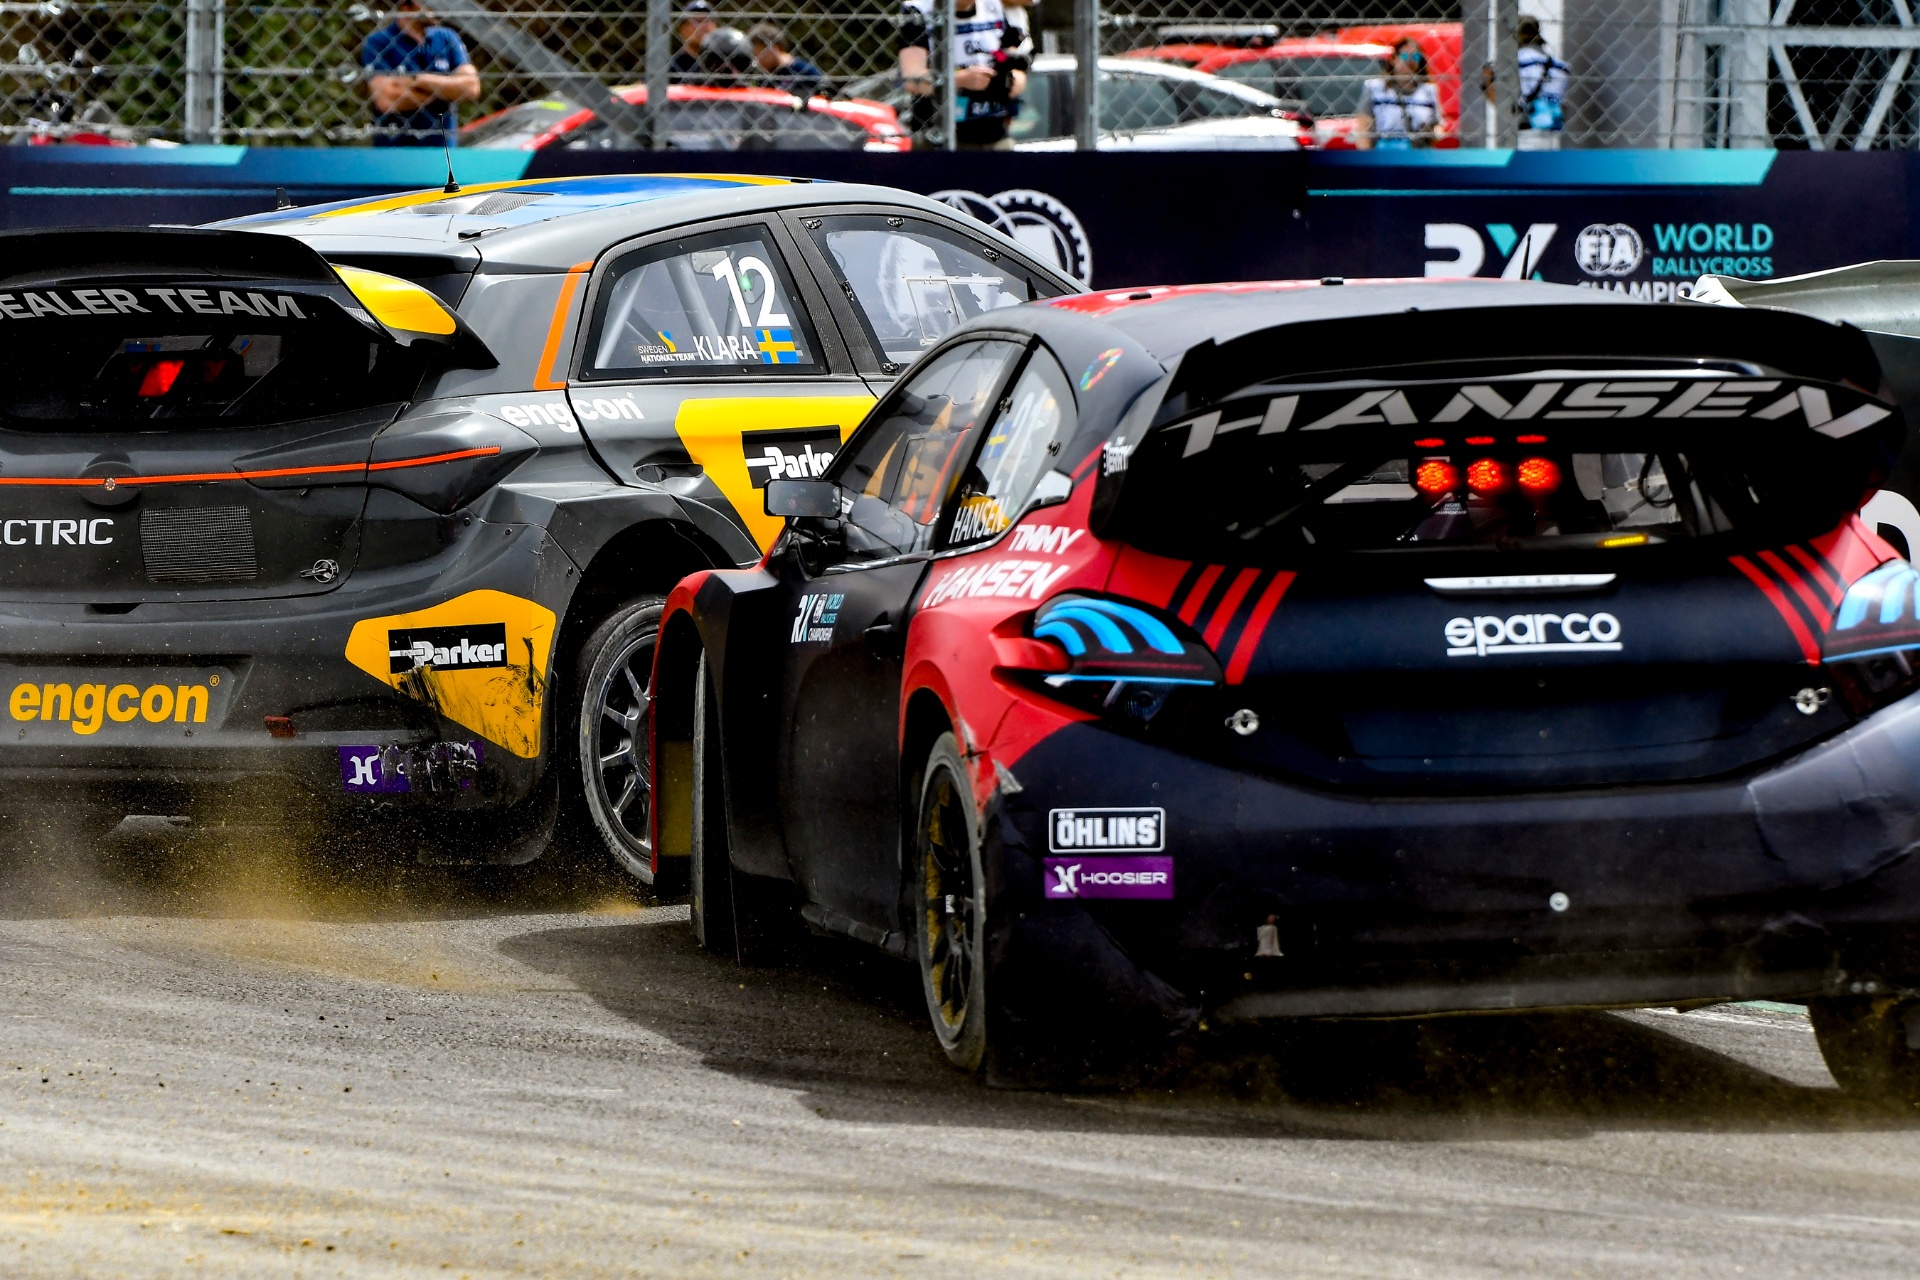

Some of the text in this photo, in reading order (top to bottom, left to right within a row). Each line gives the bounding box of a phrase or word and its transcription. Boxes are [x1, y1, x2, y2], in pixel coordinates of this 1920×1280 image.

[1580, 233, 1635, 265] FIA
[1653, 223, 1774, 252] WORLD
[1652, 256, 1774, 277] RALLYCROSS
[0, 288, 307, 320] EALER TEAM
[712, 256, 791, 328] 12
[638, 345, 669, 354] SWEDEN
[640, 352, 696, 363] NATIONAL TEAM
[693, 335, 758, 361] KLARA
[500, 397, 645, 433] engcon
[1160, 381, 1892, 459] HANSEN
[0, 519, 114, 545] CTRIC
[949, 496, 1012, 544] HANSEN
[922, 559, 1071, 610] HANSEN
[1444, 612, 1622, 656] sparco
[412, 638, 504, 668] Parker
[9, 682, 209, 735] engcon
[1056, 811, 1157, 847] ÖHLINS
[1080, 872, 1168, 885] HOOSIER
